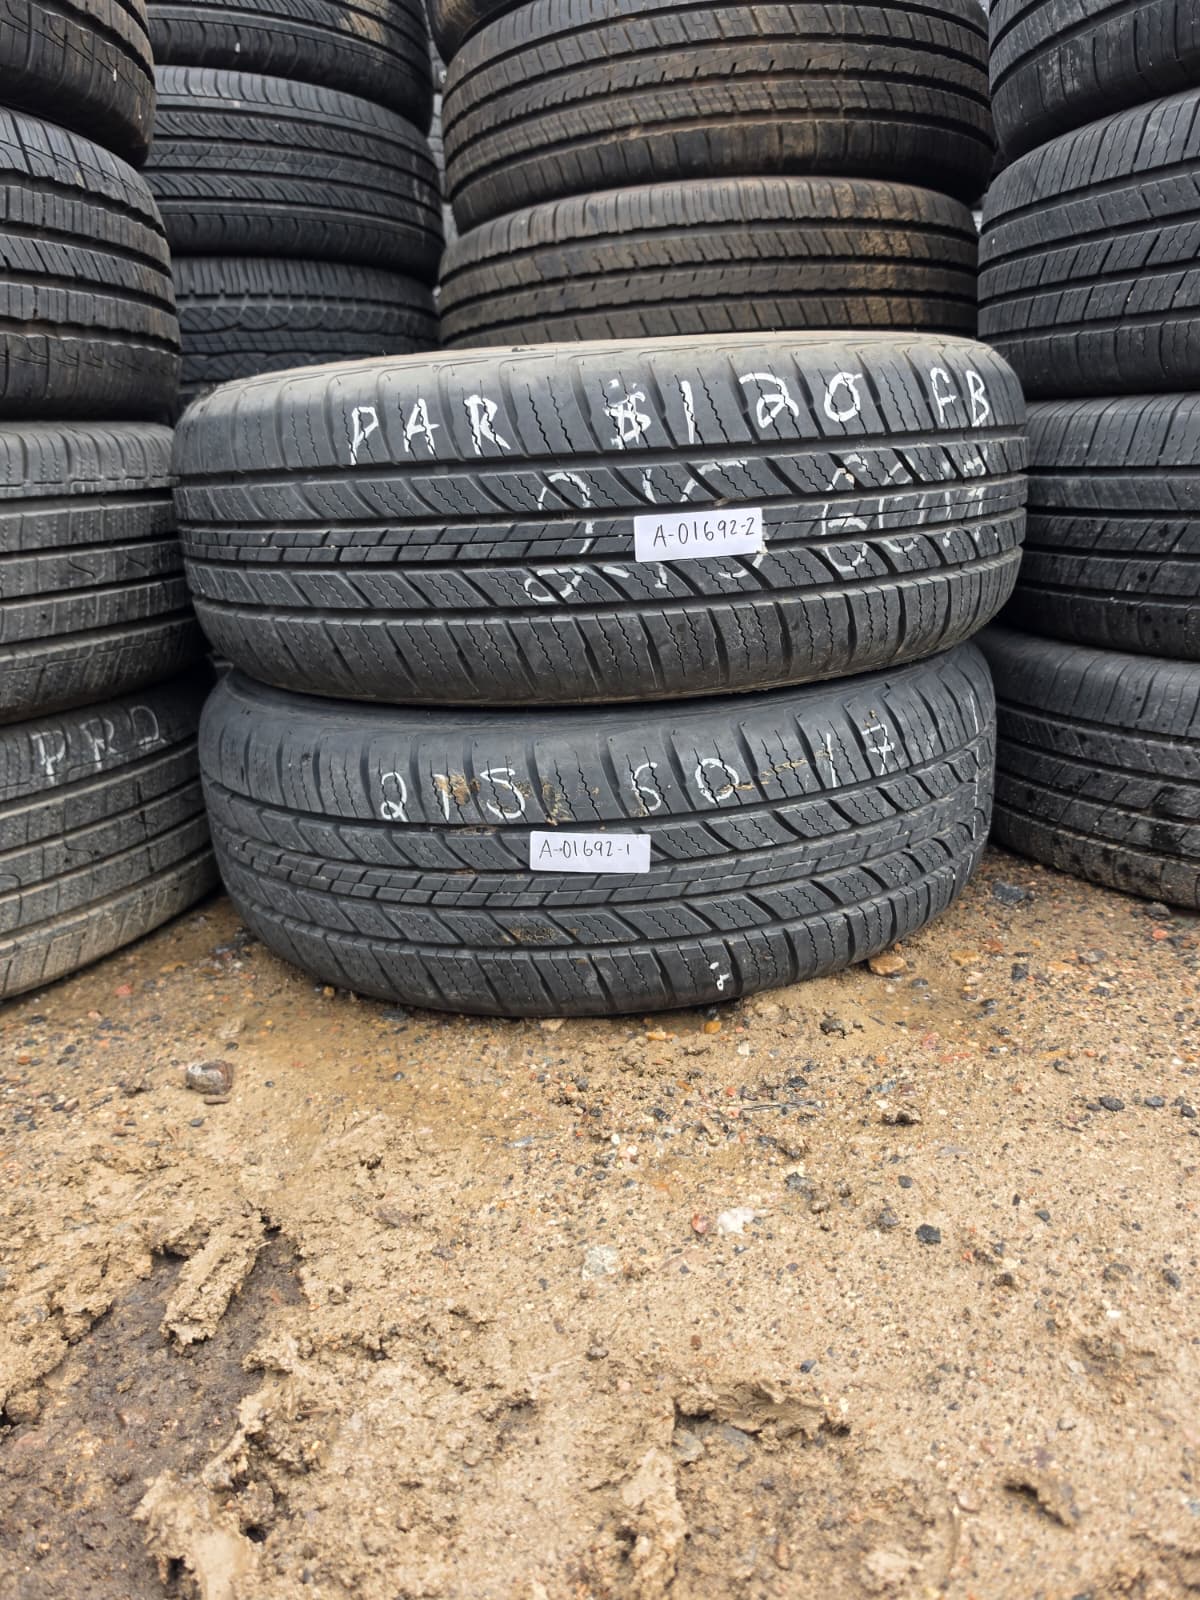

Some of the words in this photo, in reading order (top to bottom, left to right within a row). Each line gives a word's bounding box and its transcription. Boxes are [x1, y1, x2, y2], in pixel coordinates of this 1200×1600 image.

[349, 394, 511, 465] PAR
[653, 516, 756, 549] A-01692-2
[380, 767, 526, 823] 215
[538, 839, 631, 859] A-01692-1
